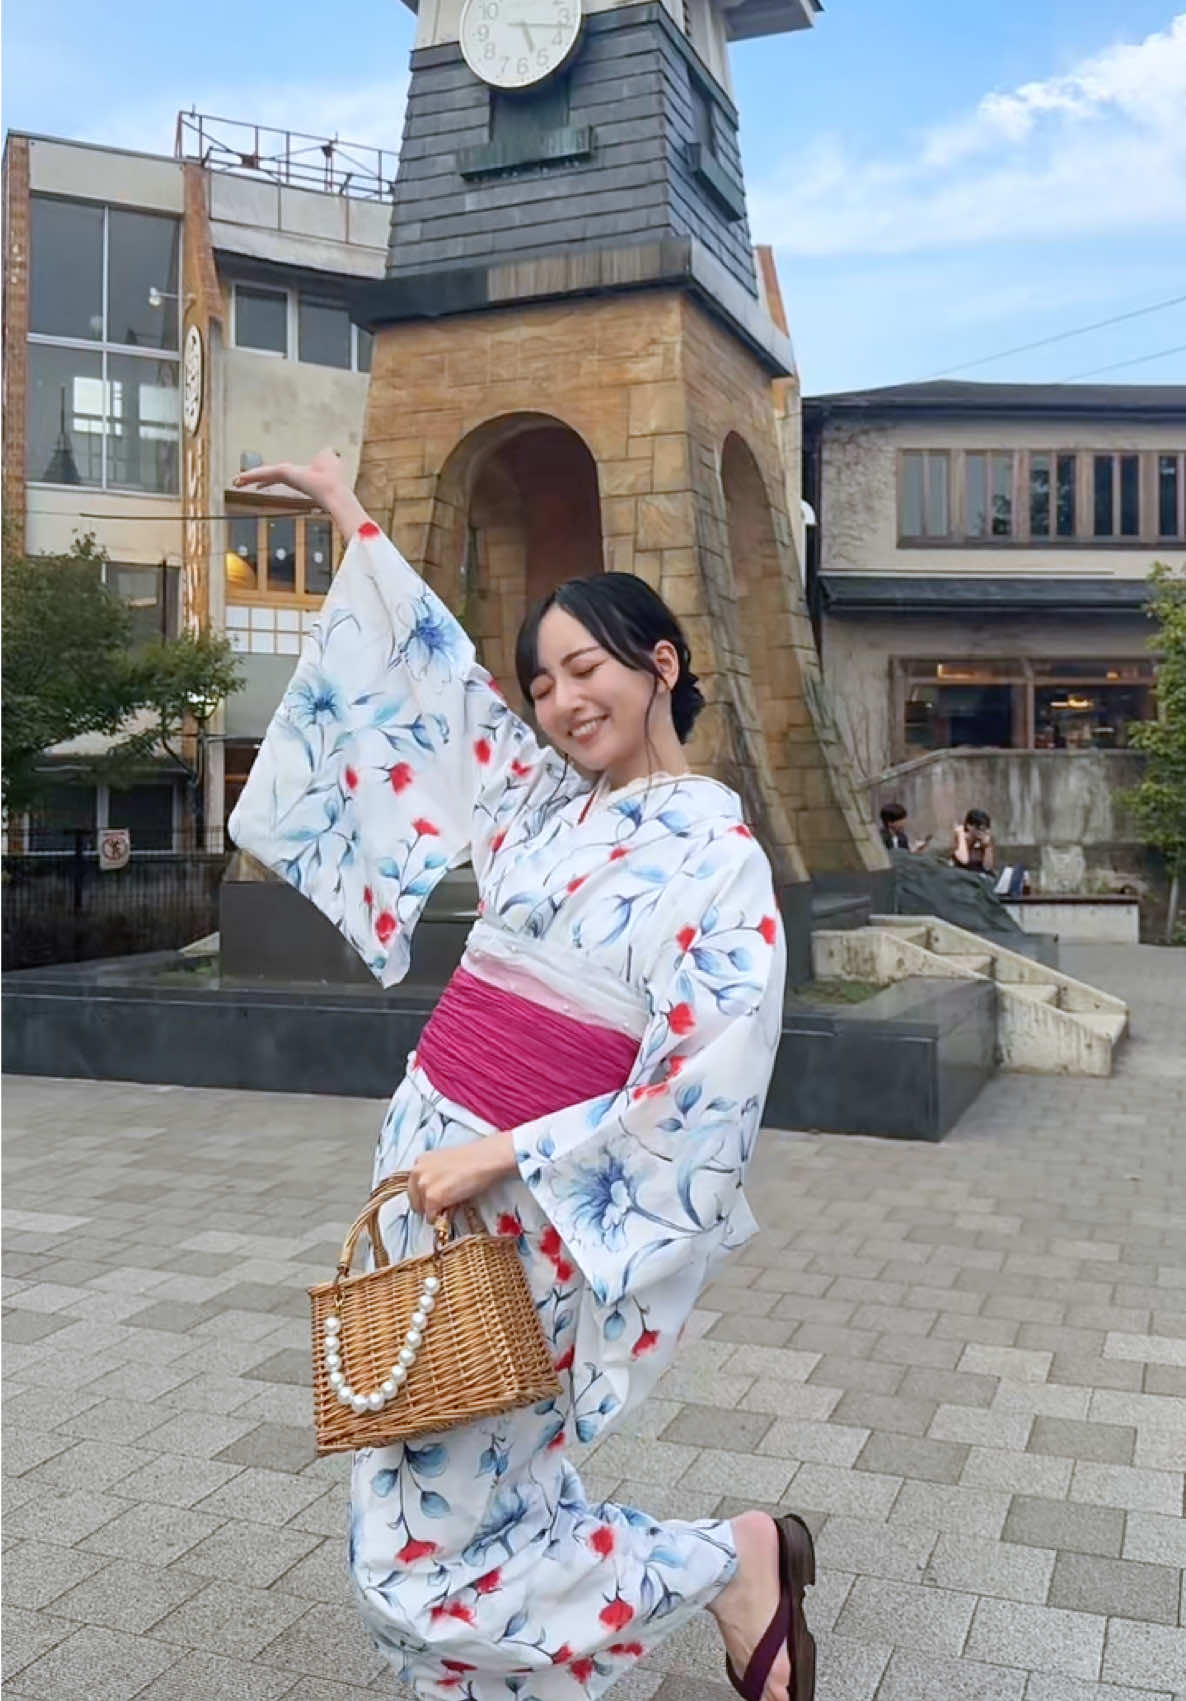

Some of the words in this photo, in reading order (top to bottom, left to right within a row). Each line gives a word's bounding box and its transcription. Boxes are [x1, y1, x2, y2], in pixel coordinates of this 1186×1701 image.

[481, 2, 498, 20] 10
[558, 8, 569, 25] 3
[478, 24, 489, 42] 9
[552, 29, 562, 45] 4
[484, 43, 496, 60] 8
[500, 56, 510, 73] 7
[517, 57, 529, 75] 6
